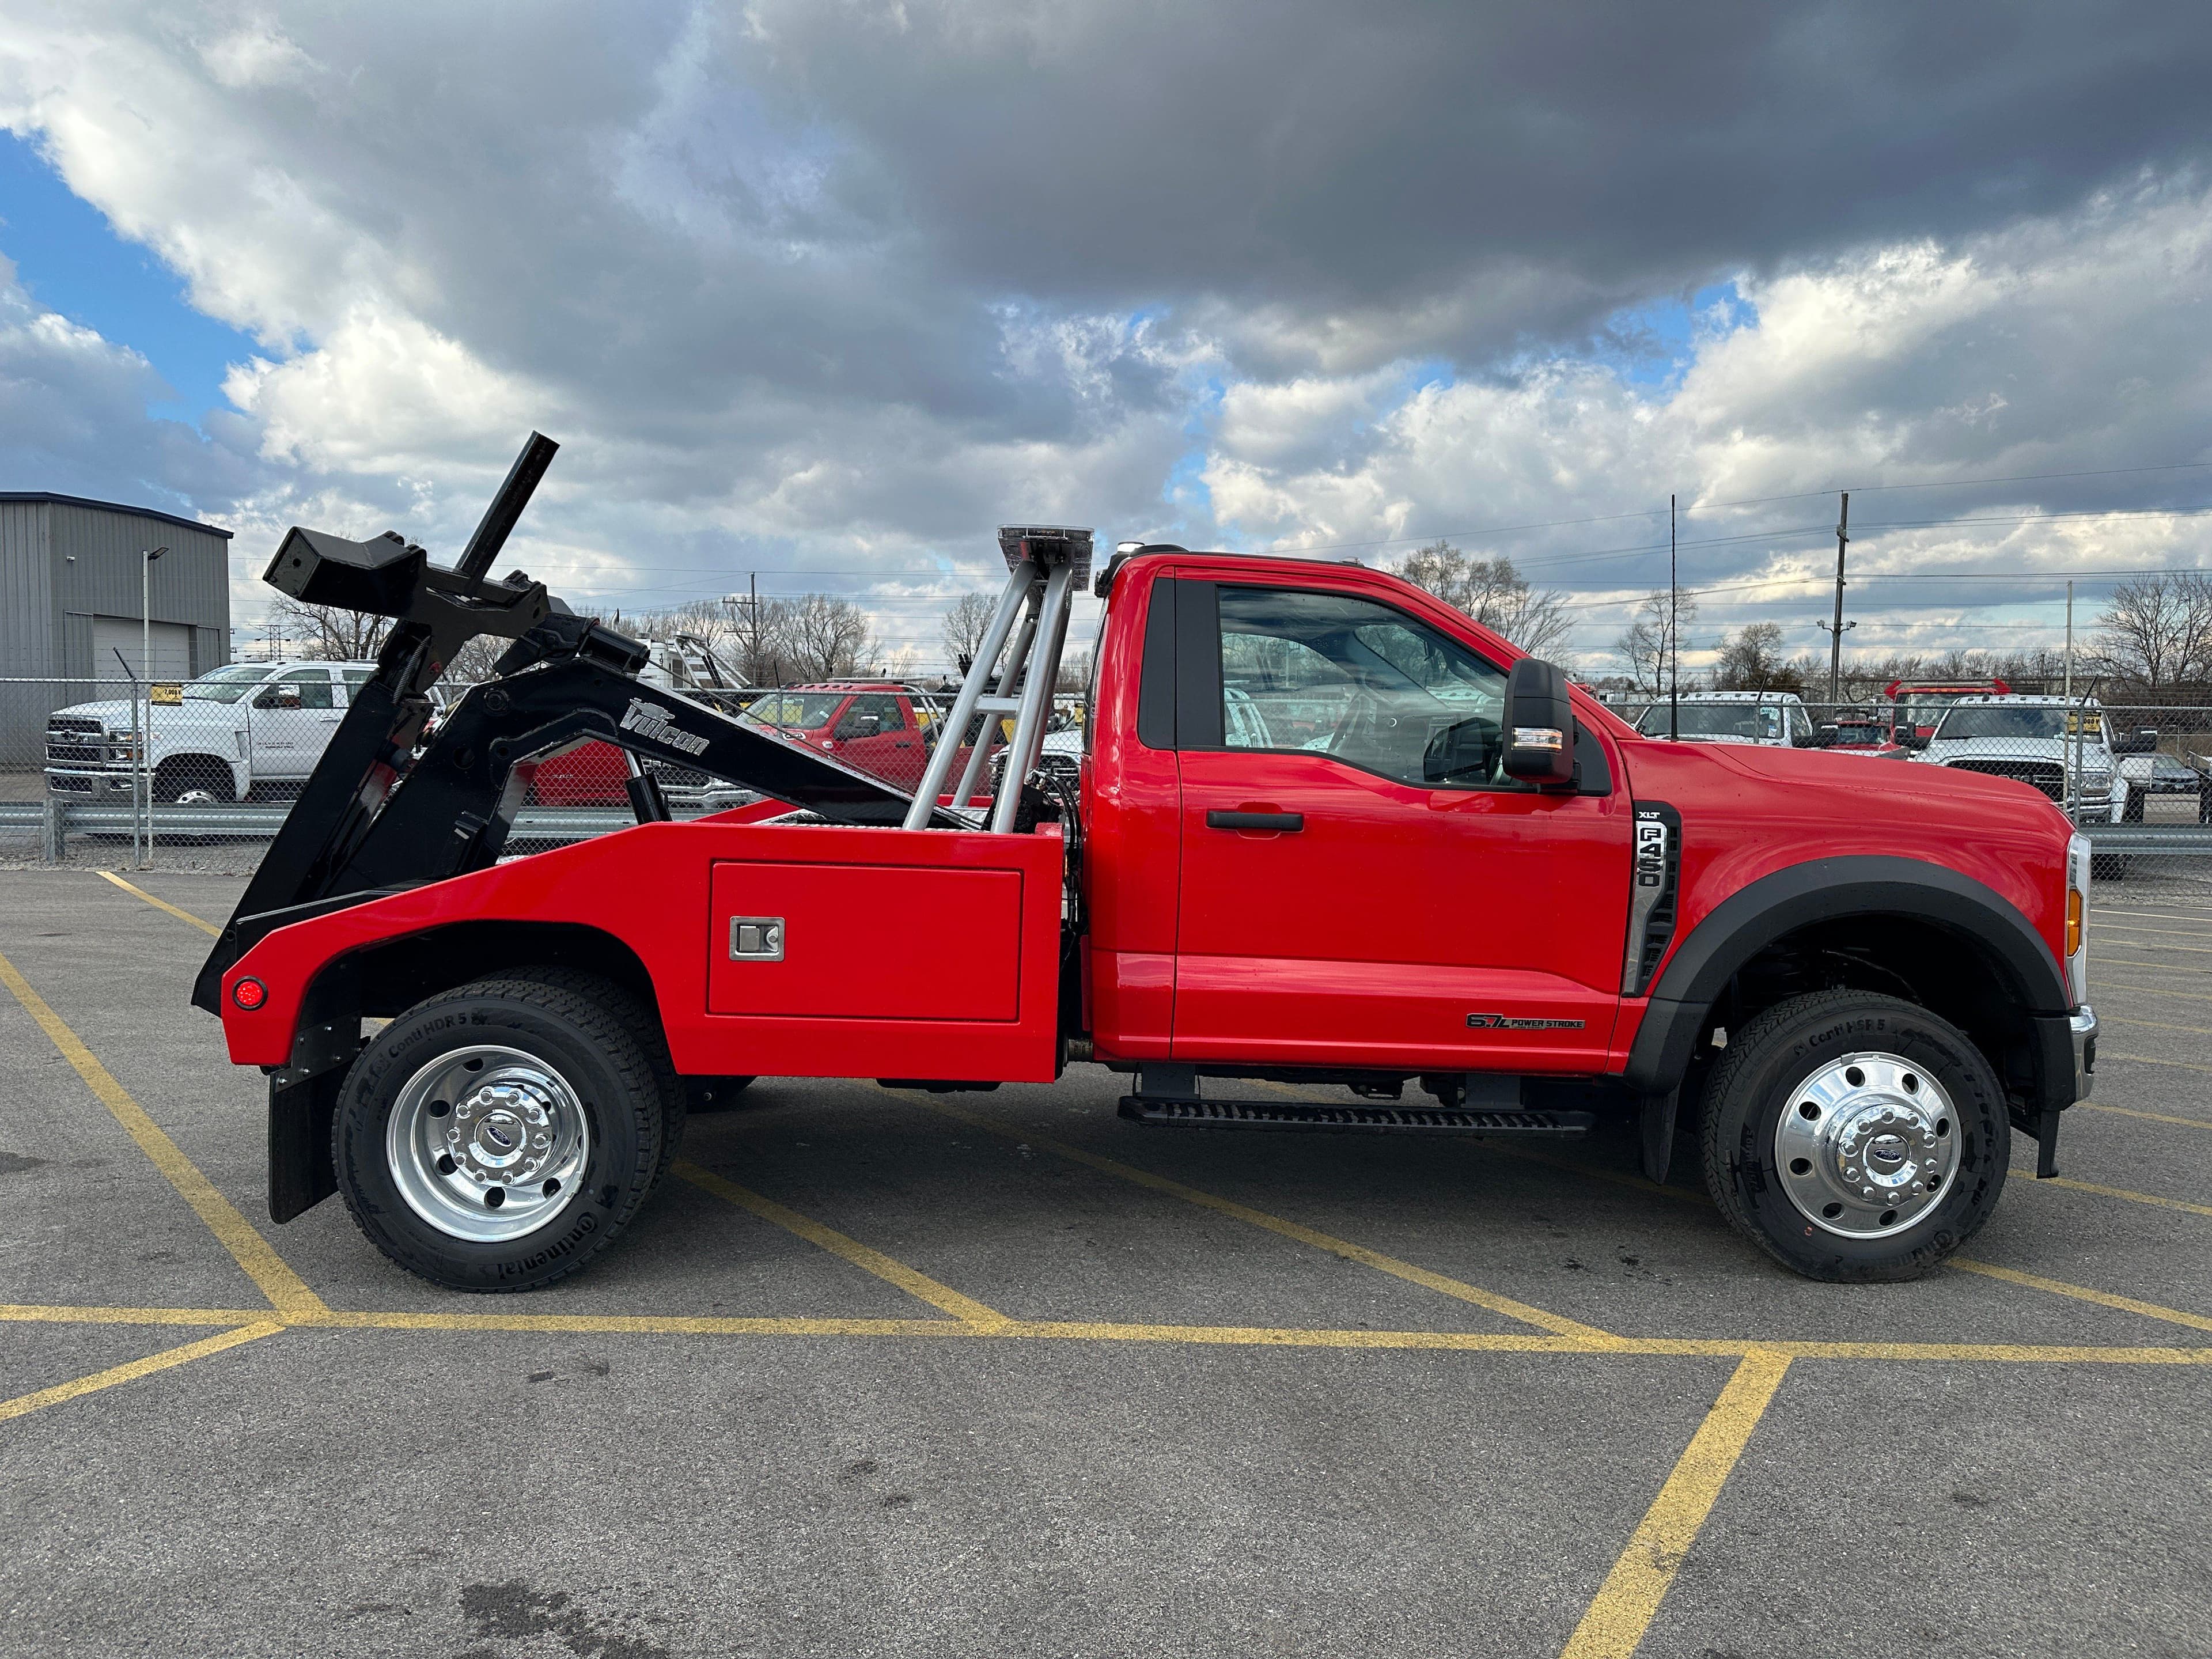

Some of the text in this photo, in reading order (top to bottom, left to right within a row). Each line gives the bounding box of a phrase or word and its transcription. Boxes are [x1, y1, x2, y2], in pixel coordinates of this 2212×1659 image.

[388, 1012, 467, 1058] Conti HDR 5
[1467, 1014, 1510, 1028] 6.7L
[1546, 1020, 1583, 1028] STROKE
[497, 1212, 599, 1280] Continental
